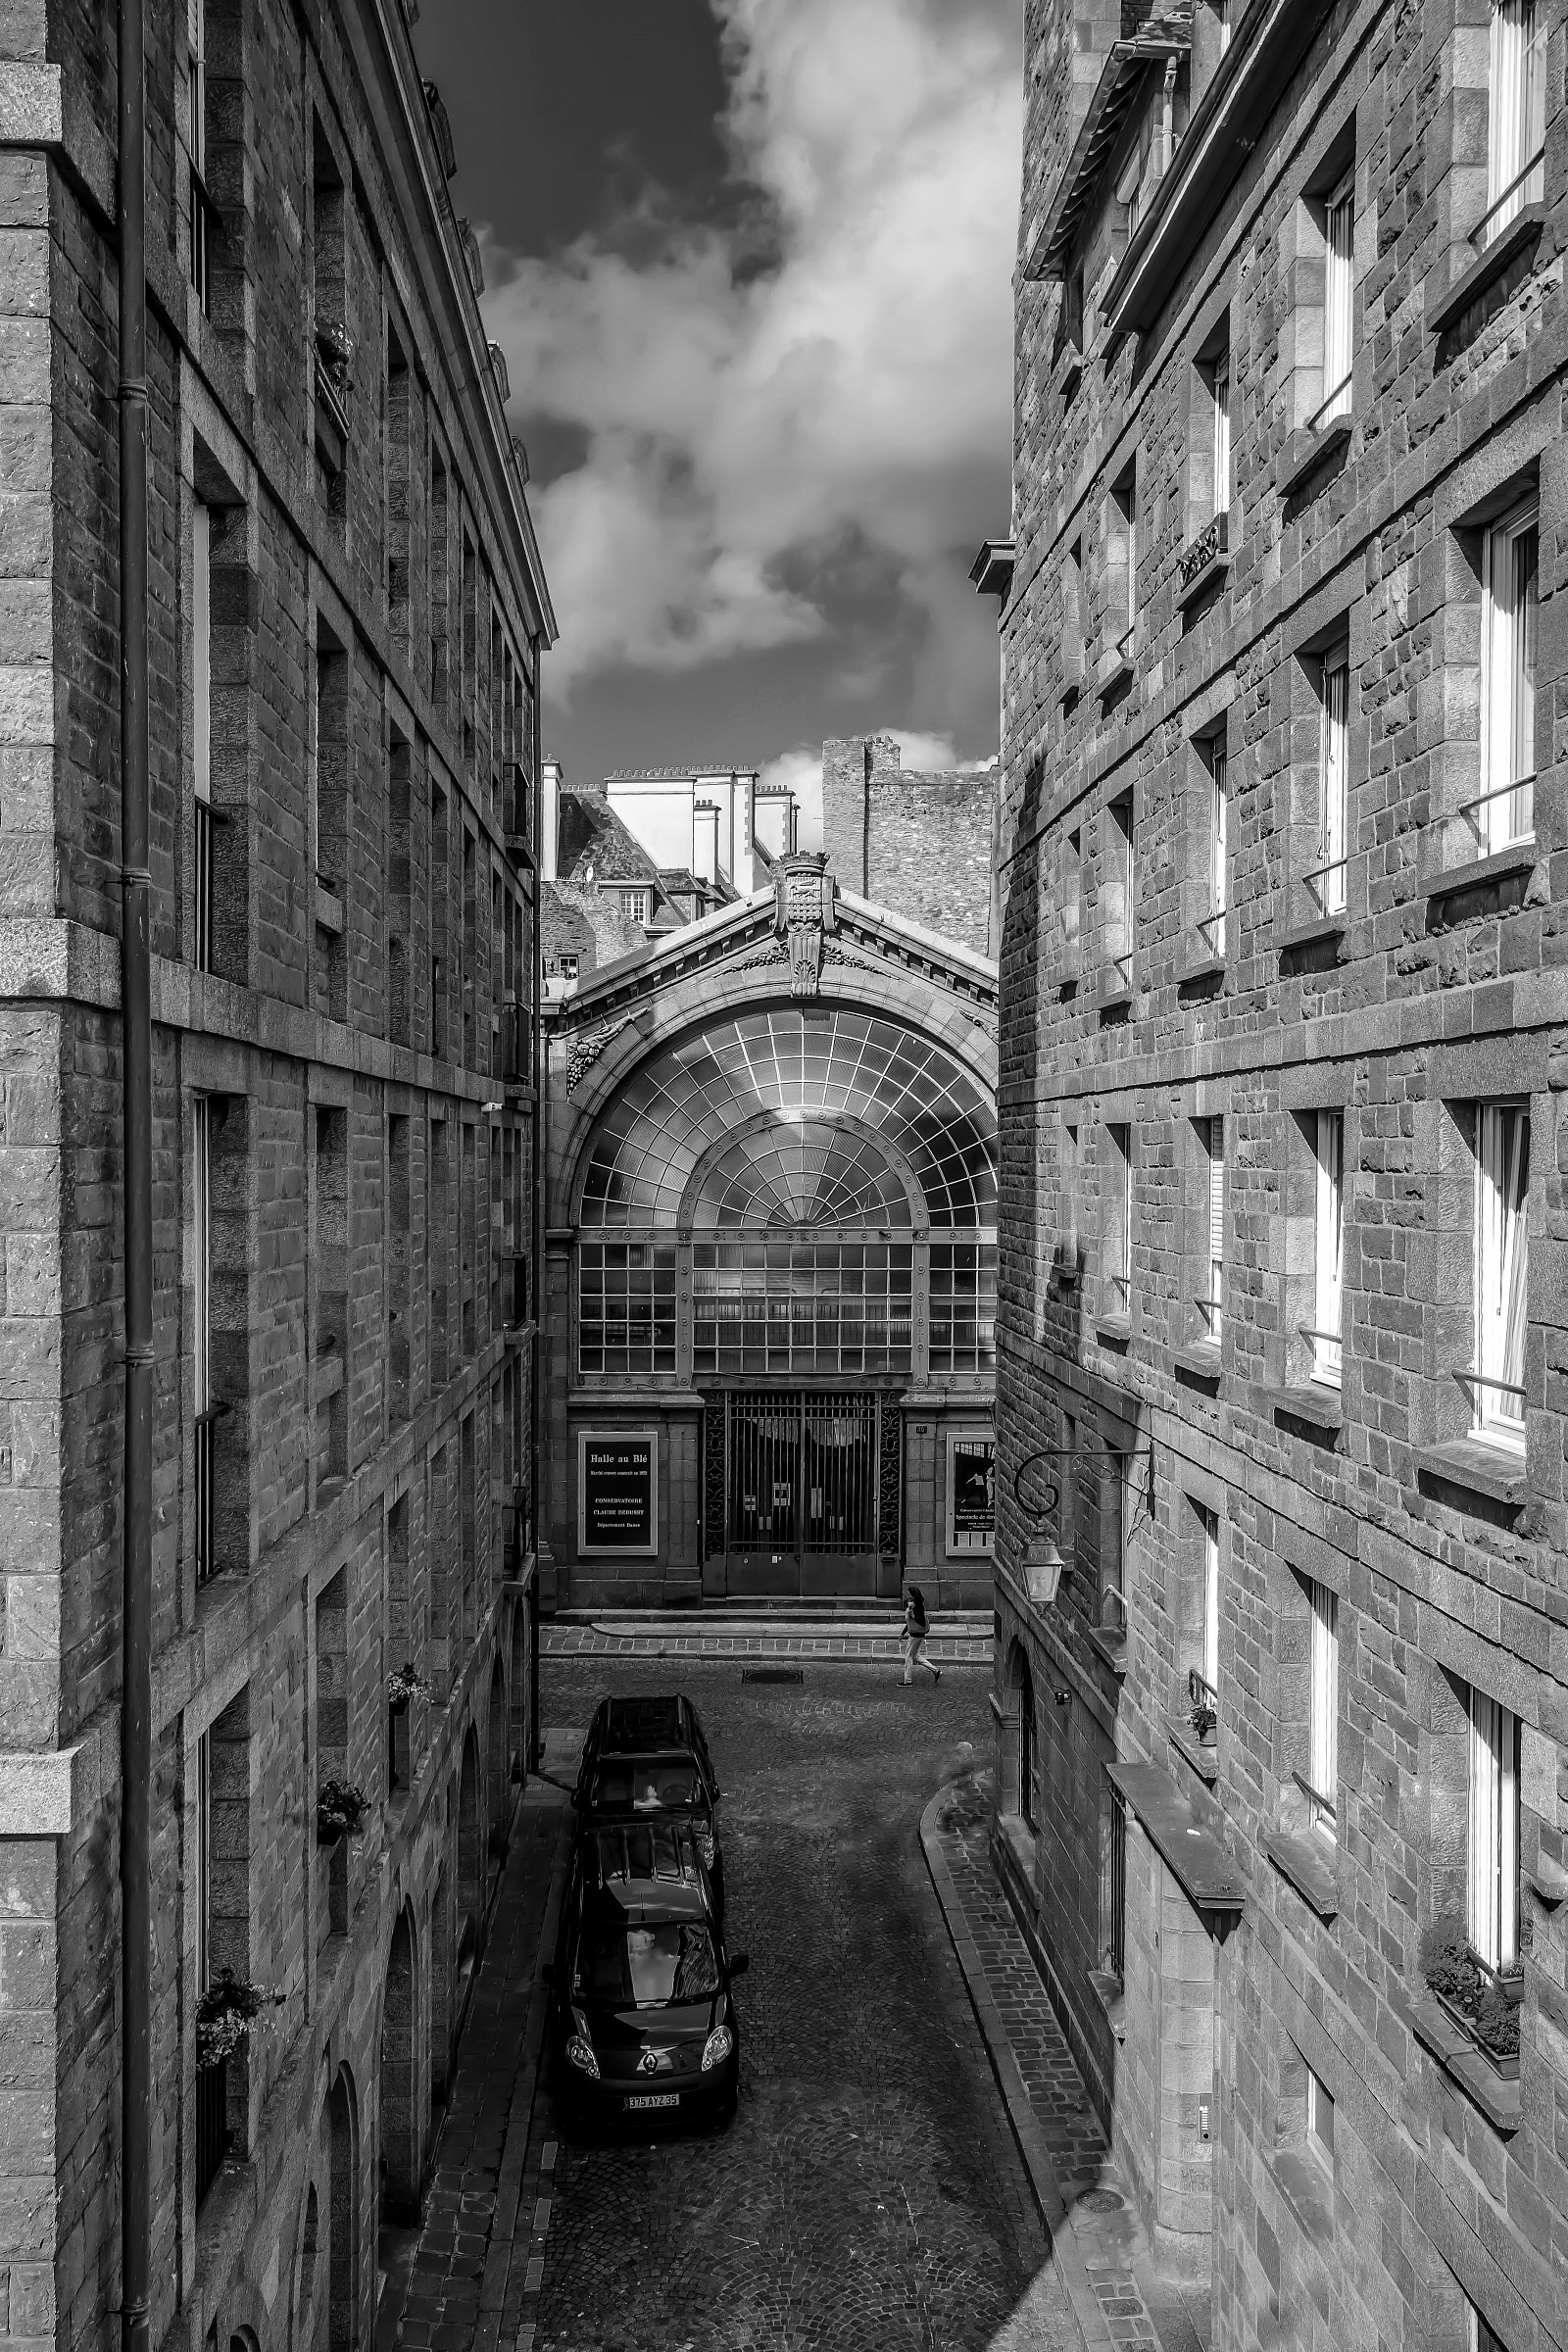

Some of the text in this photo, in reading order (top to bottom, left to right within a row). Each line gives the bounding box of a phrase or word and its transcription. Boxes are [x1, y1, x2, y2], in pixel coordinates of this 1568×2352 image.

[590, 1453, 614, 1463] Halle
[632, 1453, 648, 1463] Blé
[630, 2095, 677, 2108] 375 AYZ 35
